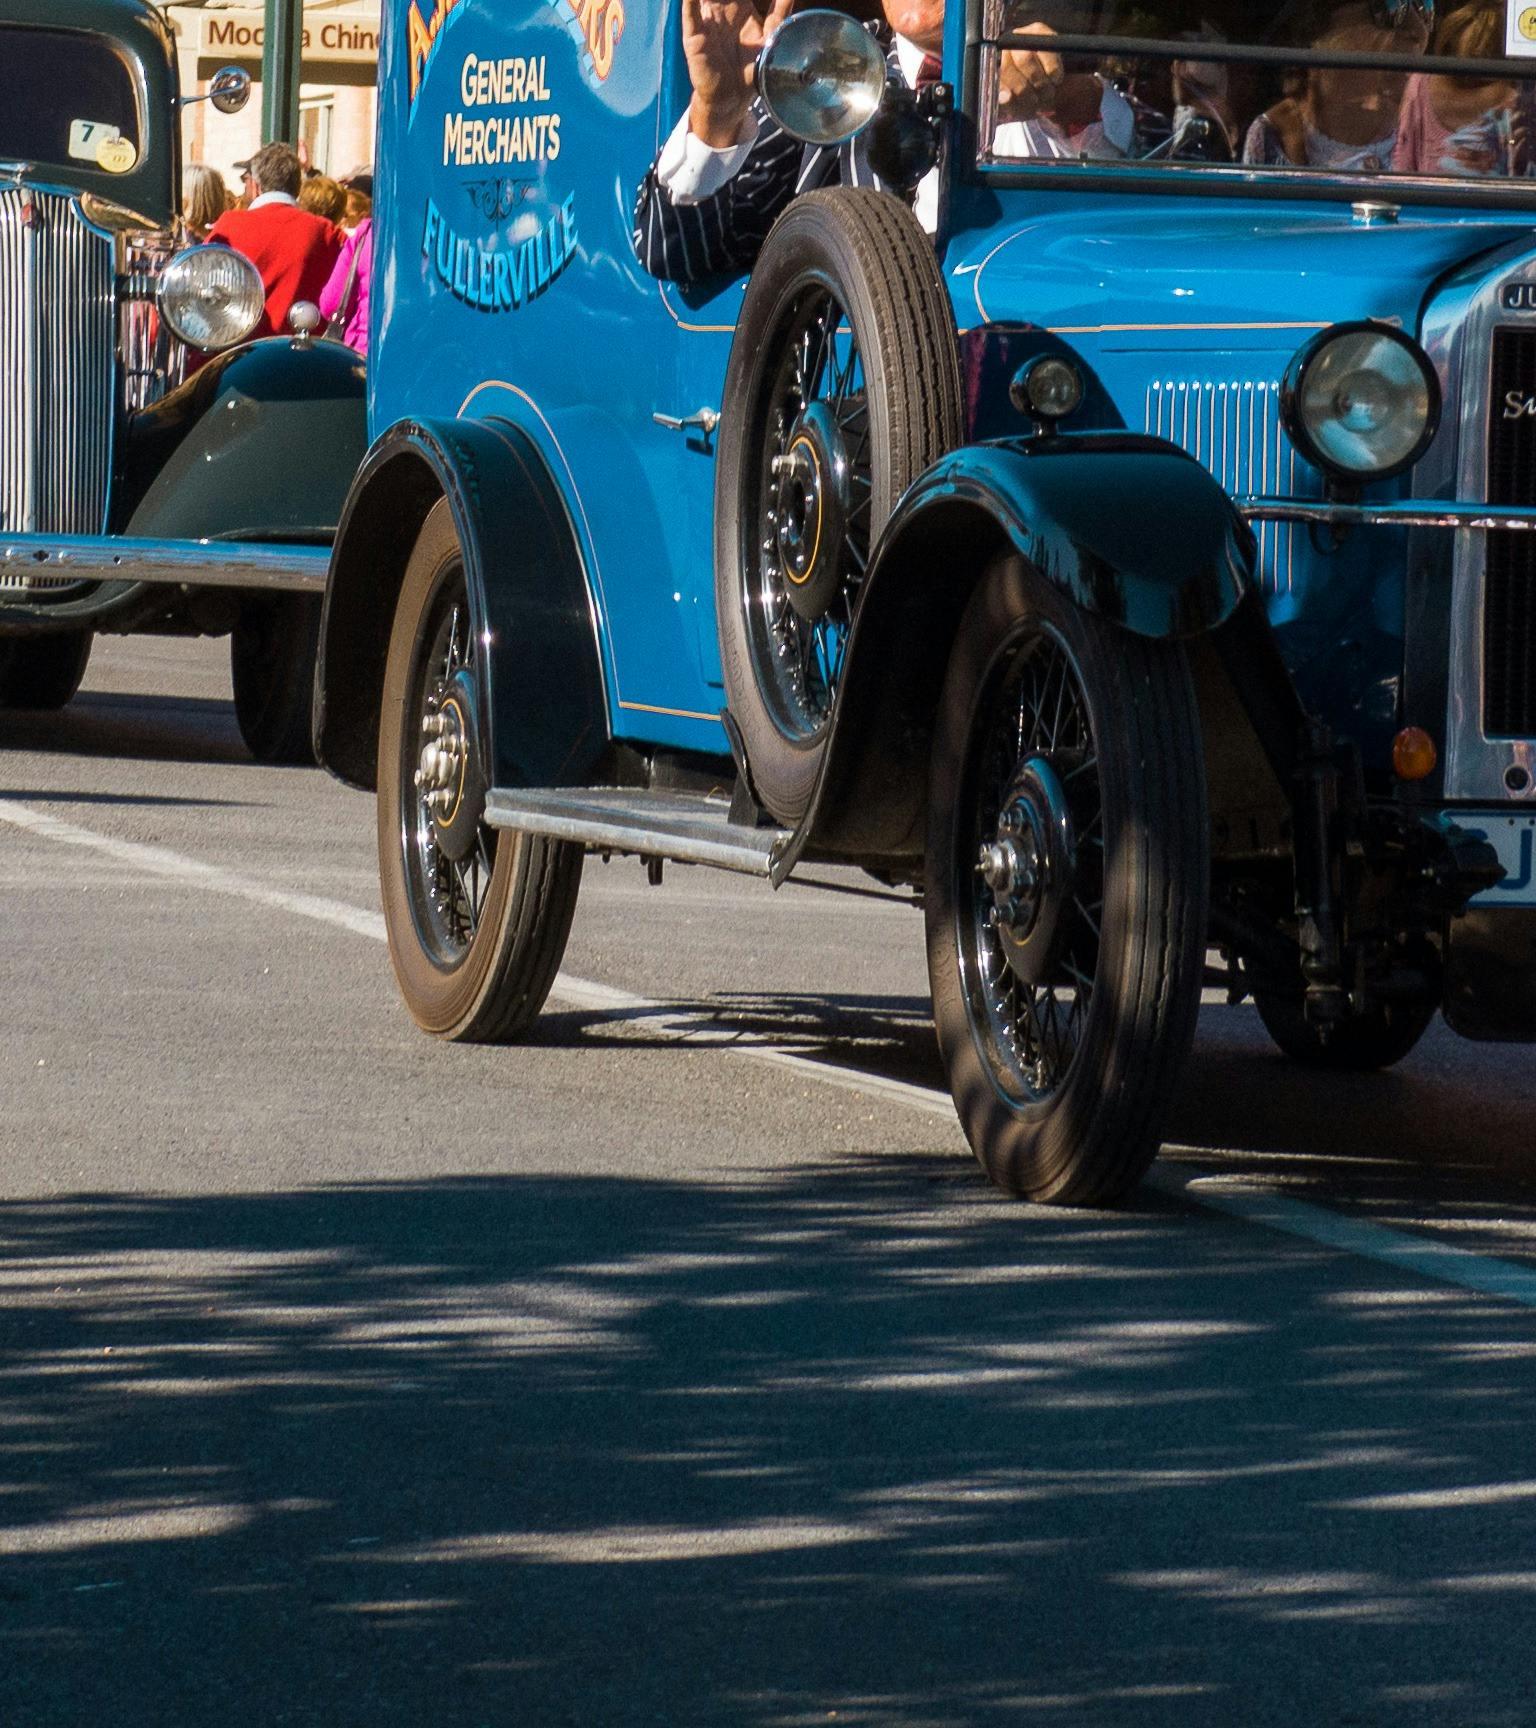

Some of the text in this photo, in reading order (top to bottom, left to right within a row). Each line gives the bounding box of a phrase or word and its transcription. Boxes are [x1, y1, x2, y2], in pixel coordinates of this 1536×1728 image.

[208, 20, 380, 50] Mooa Chin
[461, 53, 551, 107] GENERAL
[82, 124, 95, 142] 7
[443, 114, 560, 166] MERCHANTS
[423, 189, 579, 312] FULLERVILLE
